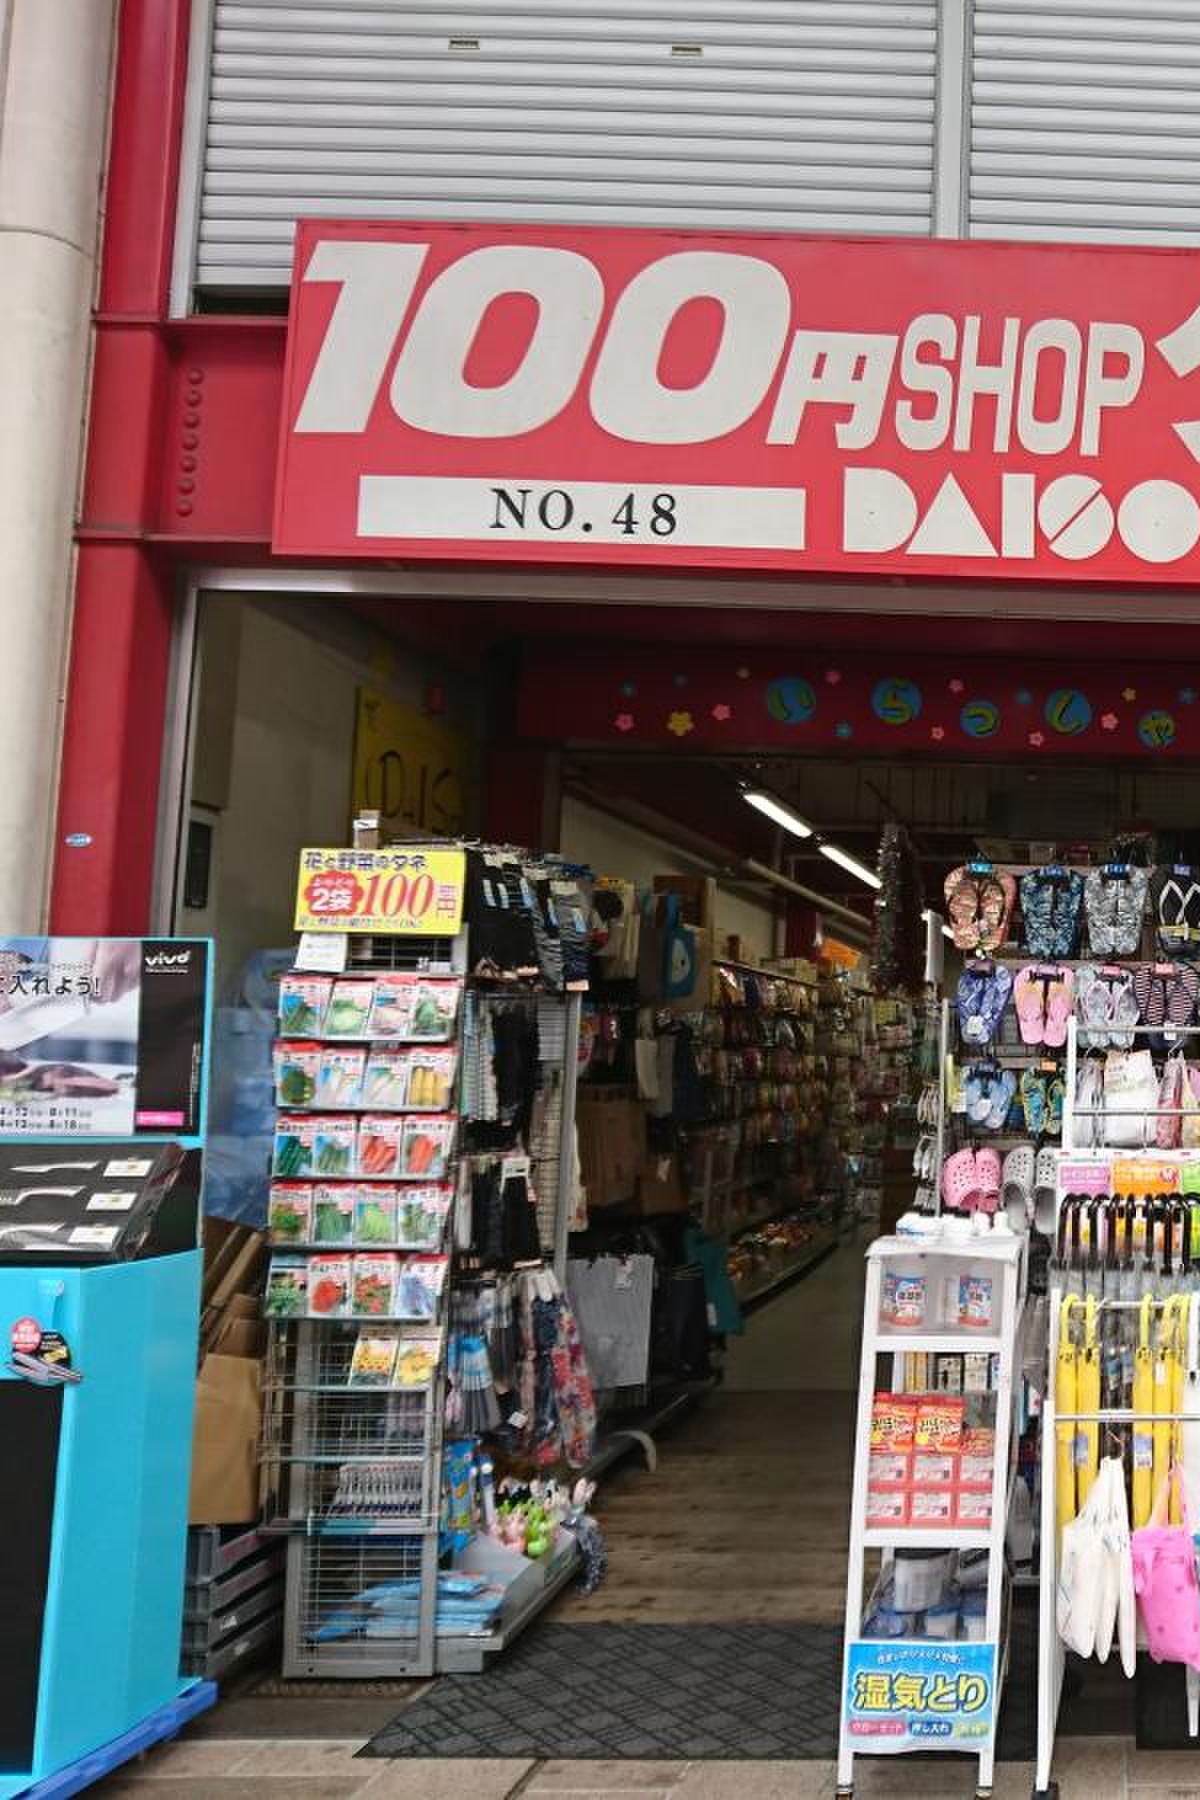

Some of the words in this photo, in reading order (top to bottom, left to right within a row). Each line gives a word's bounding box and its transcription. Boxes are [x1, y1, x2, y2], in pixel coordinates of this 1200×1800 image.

[843, 467, 1200, 563] DAISO
[853, 1671, 988, 1713] 湿気とり
